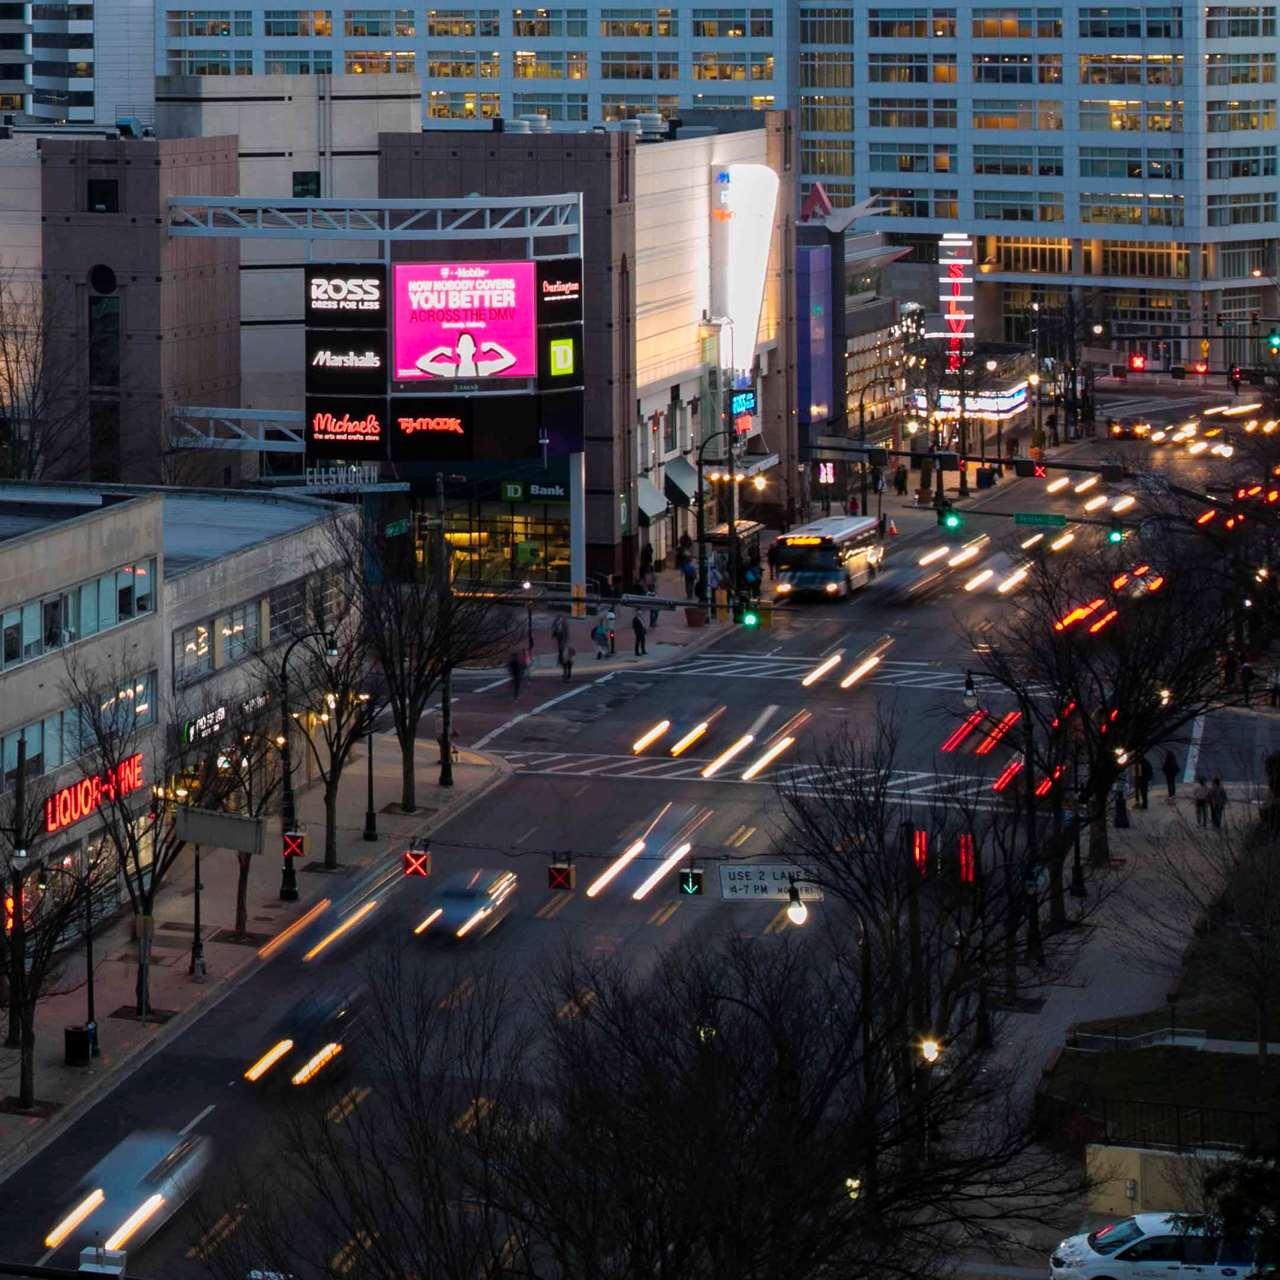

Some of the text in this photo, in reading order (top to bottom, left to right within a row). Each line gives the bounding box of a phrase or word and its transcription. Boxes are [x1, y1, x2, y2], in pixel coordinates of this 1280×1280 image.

[311, 278, 380, 300] ROSS
[408, 278, 516, 291] NOW NOBODY COVERS
[311, 301, 380, 310] DRESS FOR LESS
[408, 290, 516, 309] YOU BETTER
[410, 307, 516, 322] ACROSS THE DMV
[312, 350, 380, 367] Marshalls
[552, 345, 573, 369] TD
[313, 413, 380, 433] Michaels
[348, 433, 364, 441] crafts
[306, 465, 378, 485] ELLSWORTH
[506, 484, 565, 497] TD Bank
[728, 871, 752, 881] USE
[759, 871, 766, 881] 2
[753, 884, 768, 895] PM
